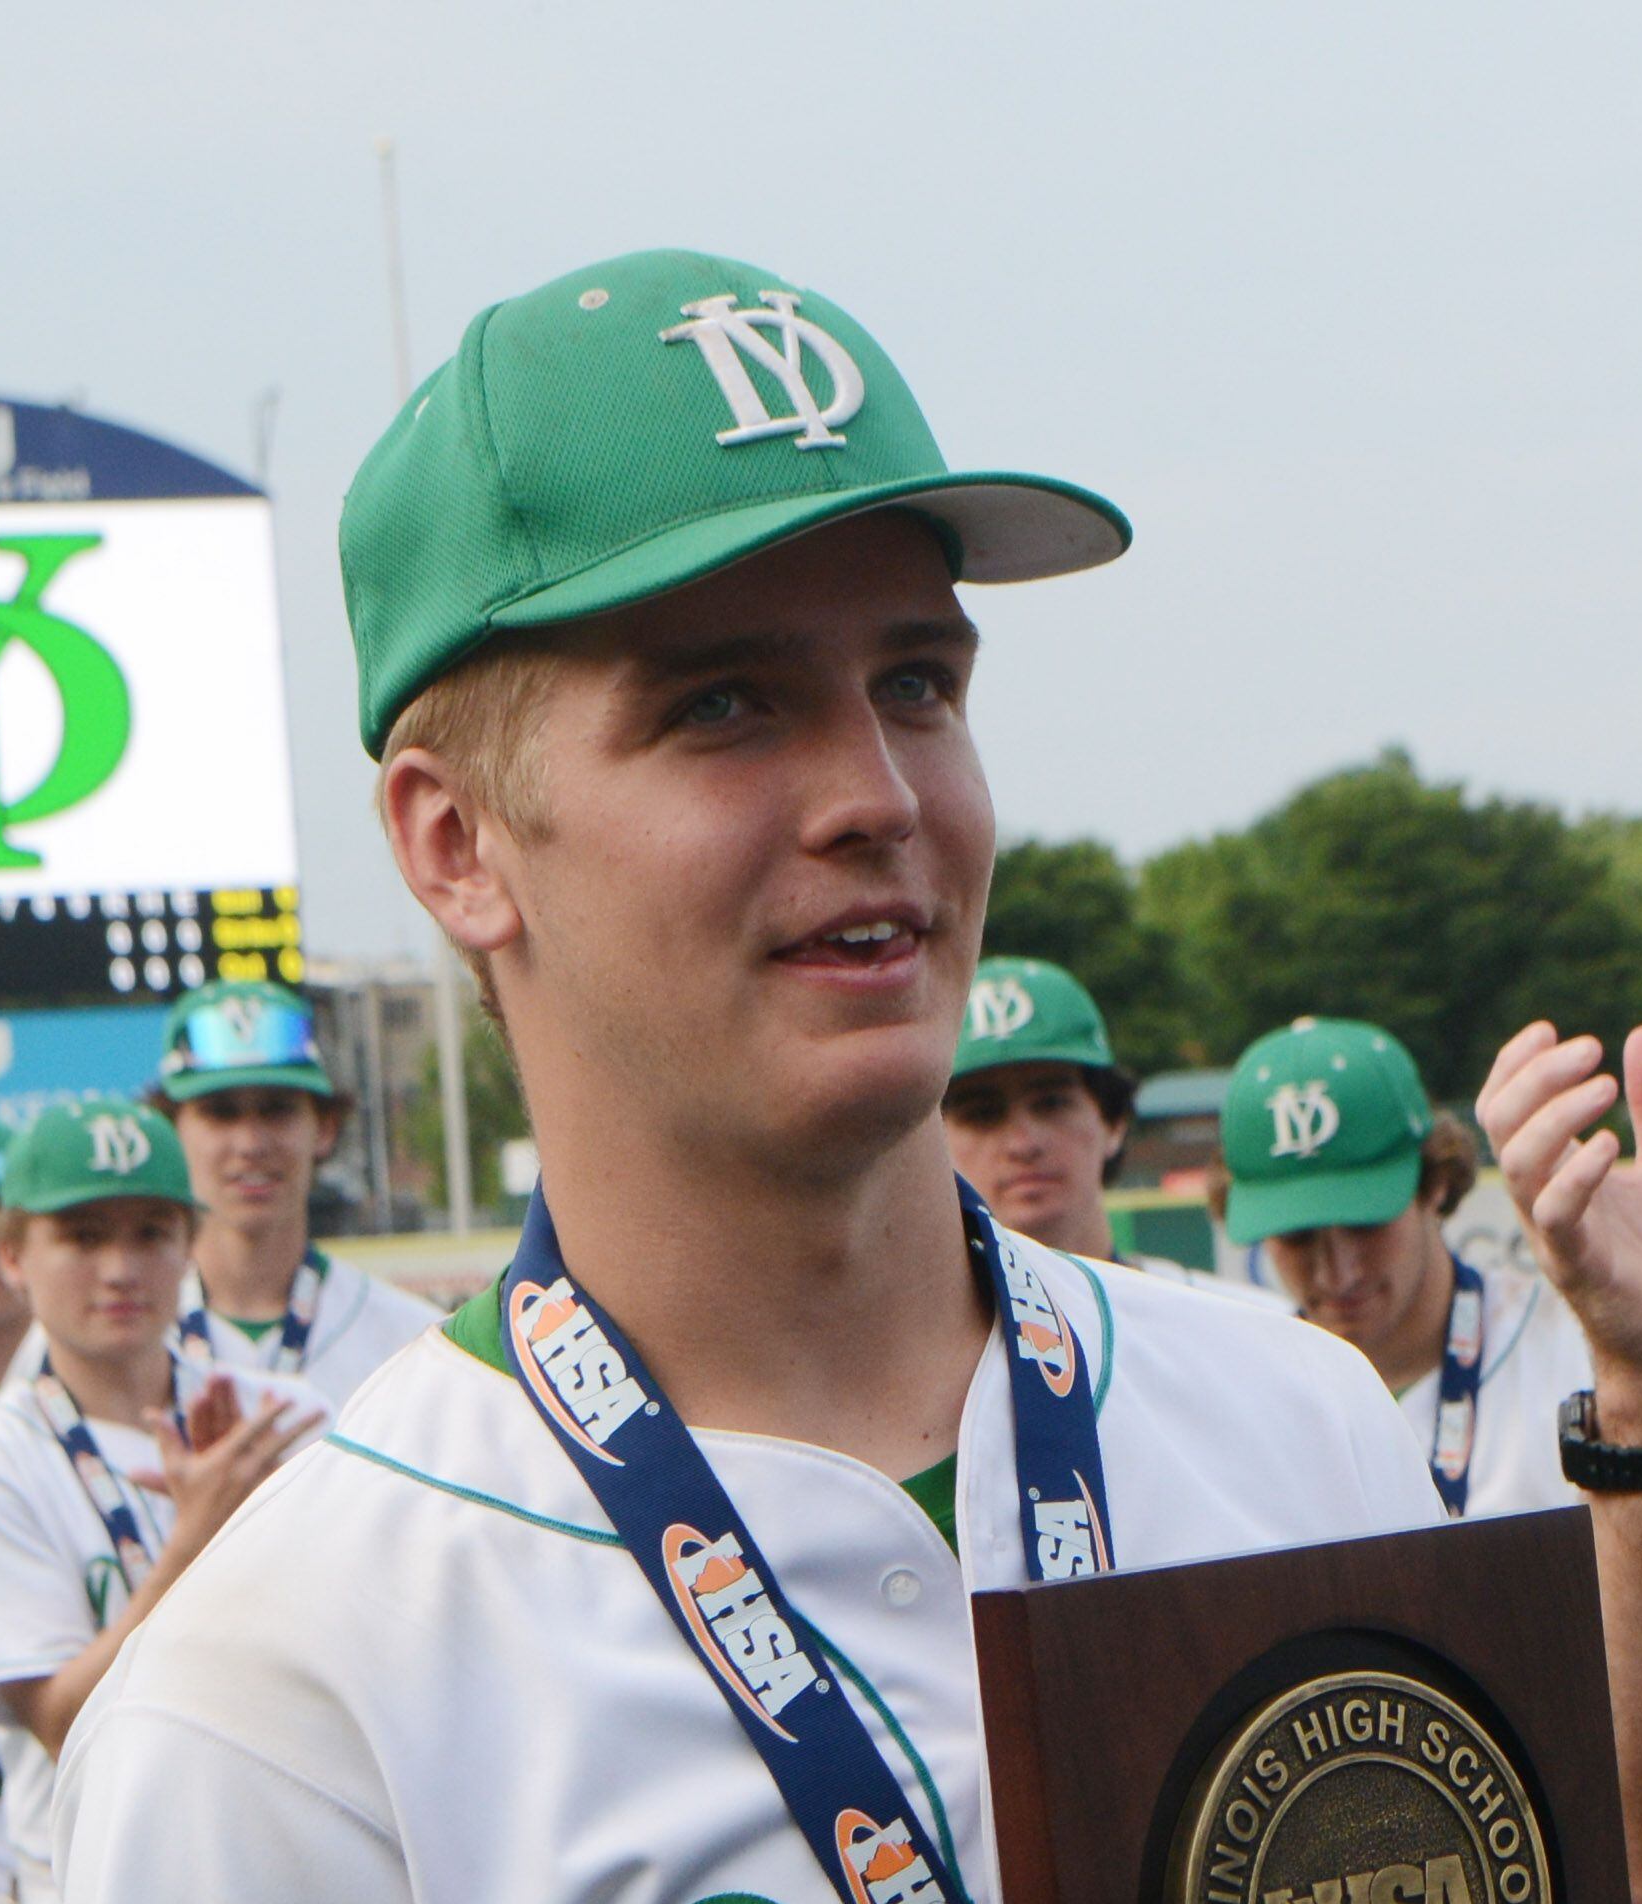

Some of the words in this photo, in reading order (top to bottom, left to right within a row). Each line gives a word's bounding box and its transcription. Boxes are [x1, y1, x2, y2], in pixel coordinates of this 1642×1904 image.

[515, 1277, 648, 1446] IHSA
[675, 1531, 817, 1718] IHSA
[1293, 1698, 1406, 1761] HIGH
